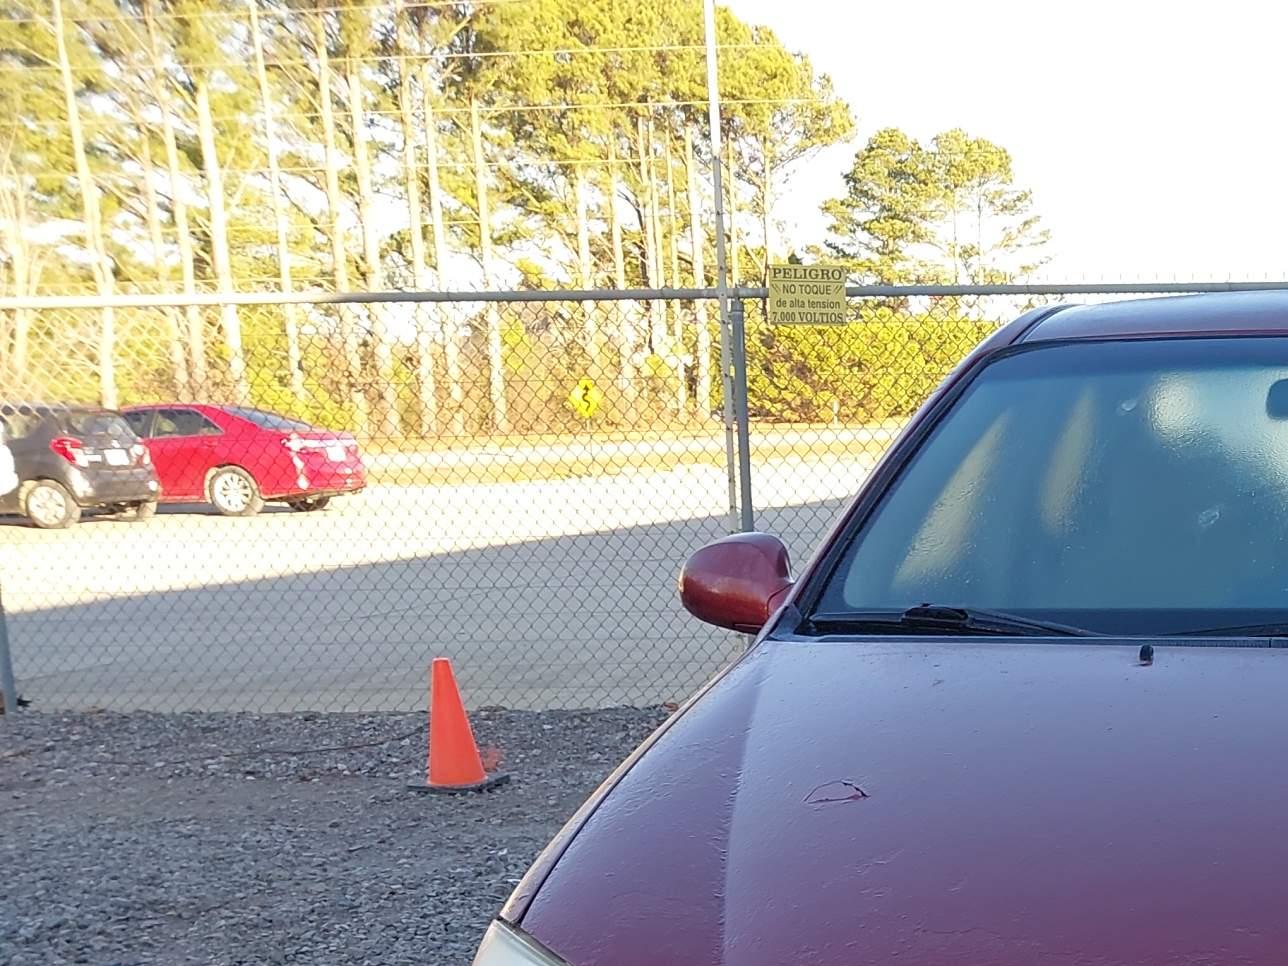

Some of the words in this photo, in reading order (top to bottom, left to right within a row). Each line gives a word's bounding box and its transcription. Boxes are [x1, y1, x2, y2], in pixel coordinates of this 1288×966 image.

[773, 267, 842, 280] PELIGRO
[782, 283, 796, 295] NO
[799, 284, 832, 296] TOQUE
[776, 297, 787, 308] de
[789, 298, 805, 308] alta
[808, 299, 841, 309] tension
[772, 311, 796, 322] 7.000
[798, 312, 843, 323] VOLTIOS
